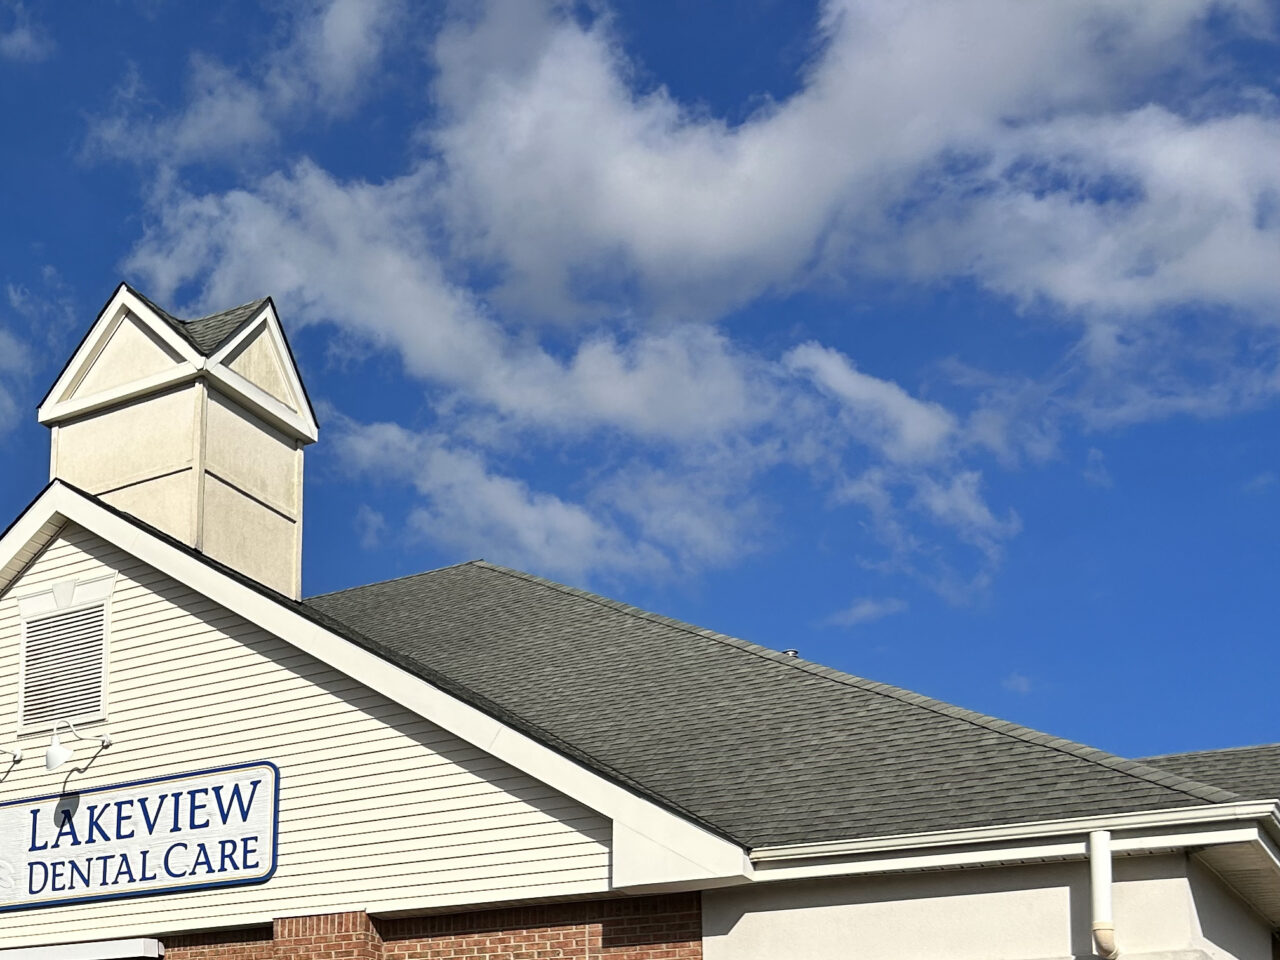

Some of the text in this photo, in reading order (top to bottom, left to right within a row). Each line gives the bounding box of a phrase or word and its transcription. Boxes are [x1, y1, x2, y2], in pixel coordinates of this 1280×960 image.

[28, 779, 262, 852] LAKEVIEW
[28, 836, 261, 895] DENTAL CARE
